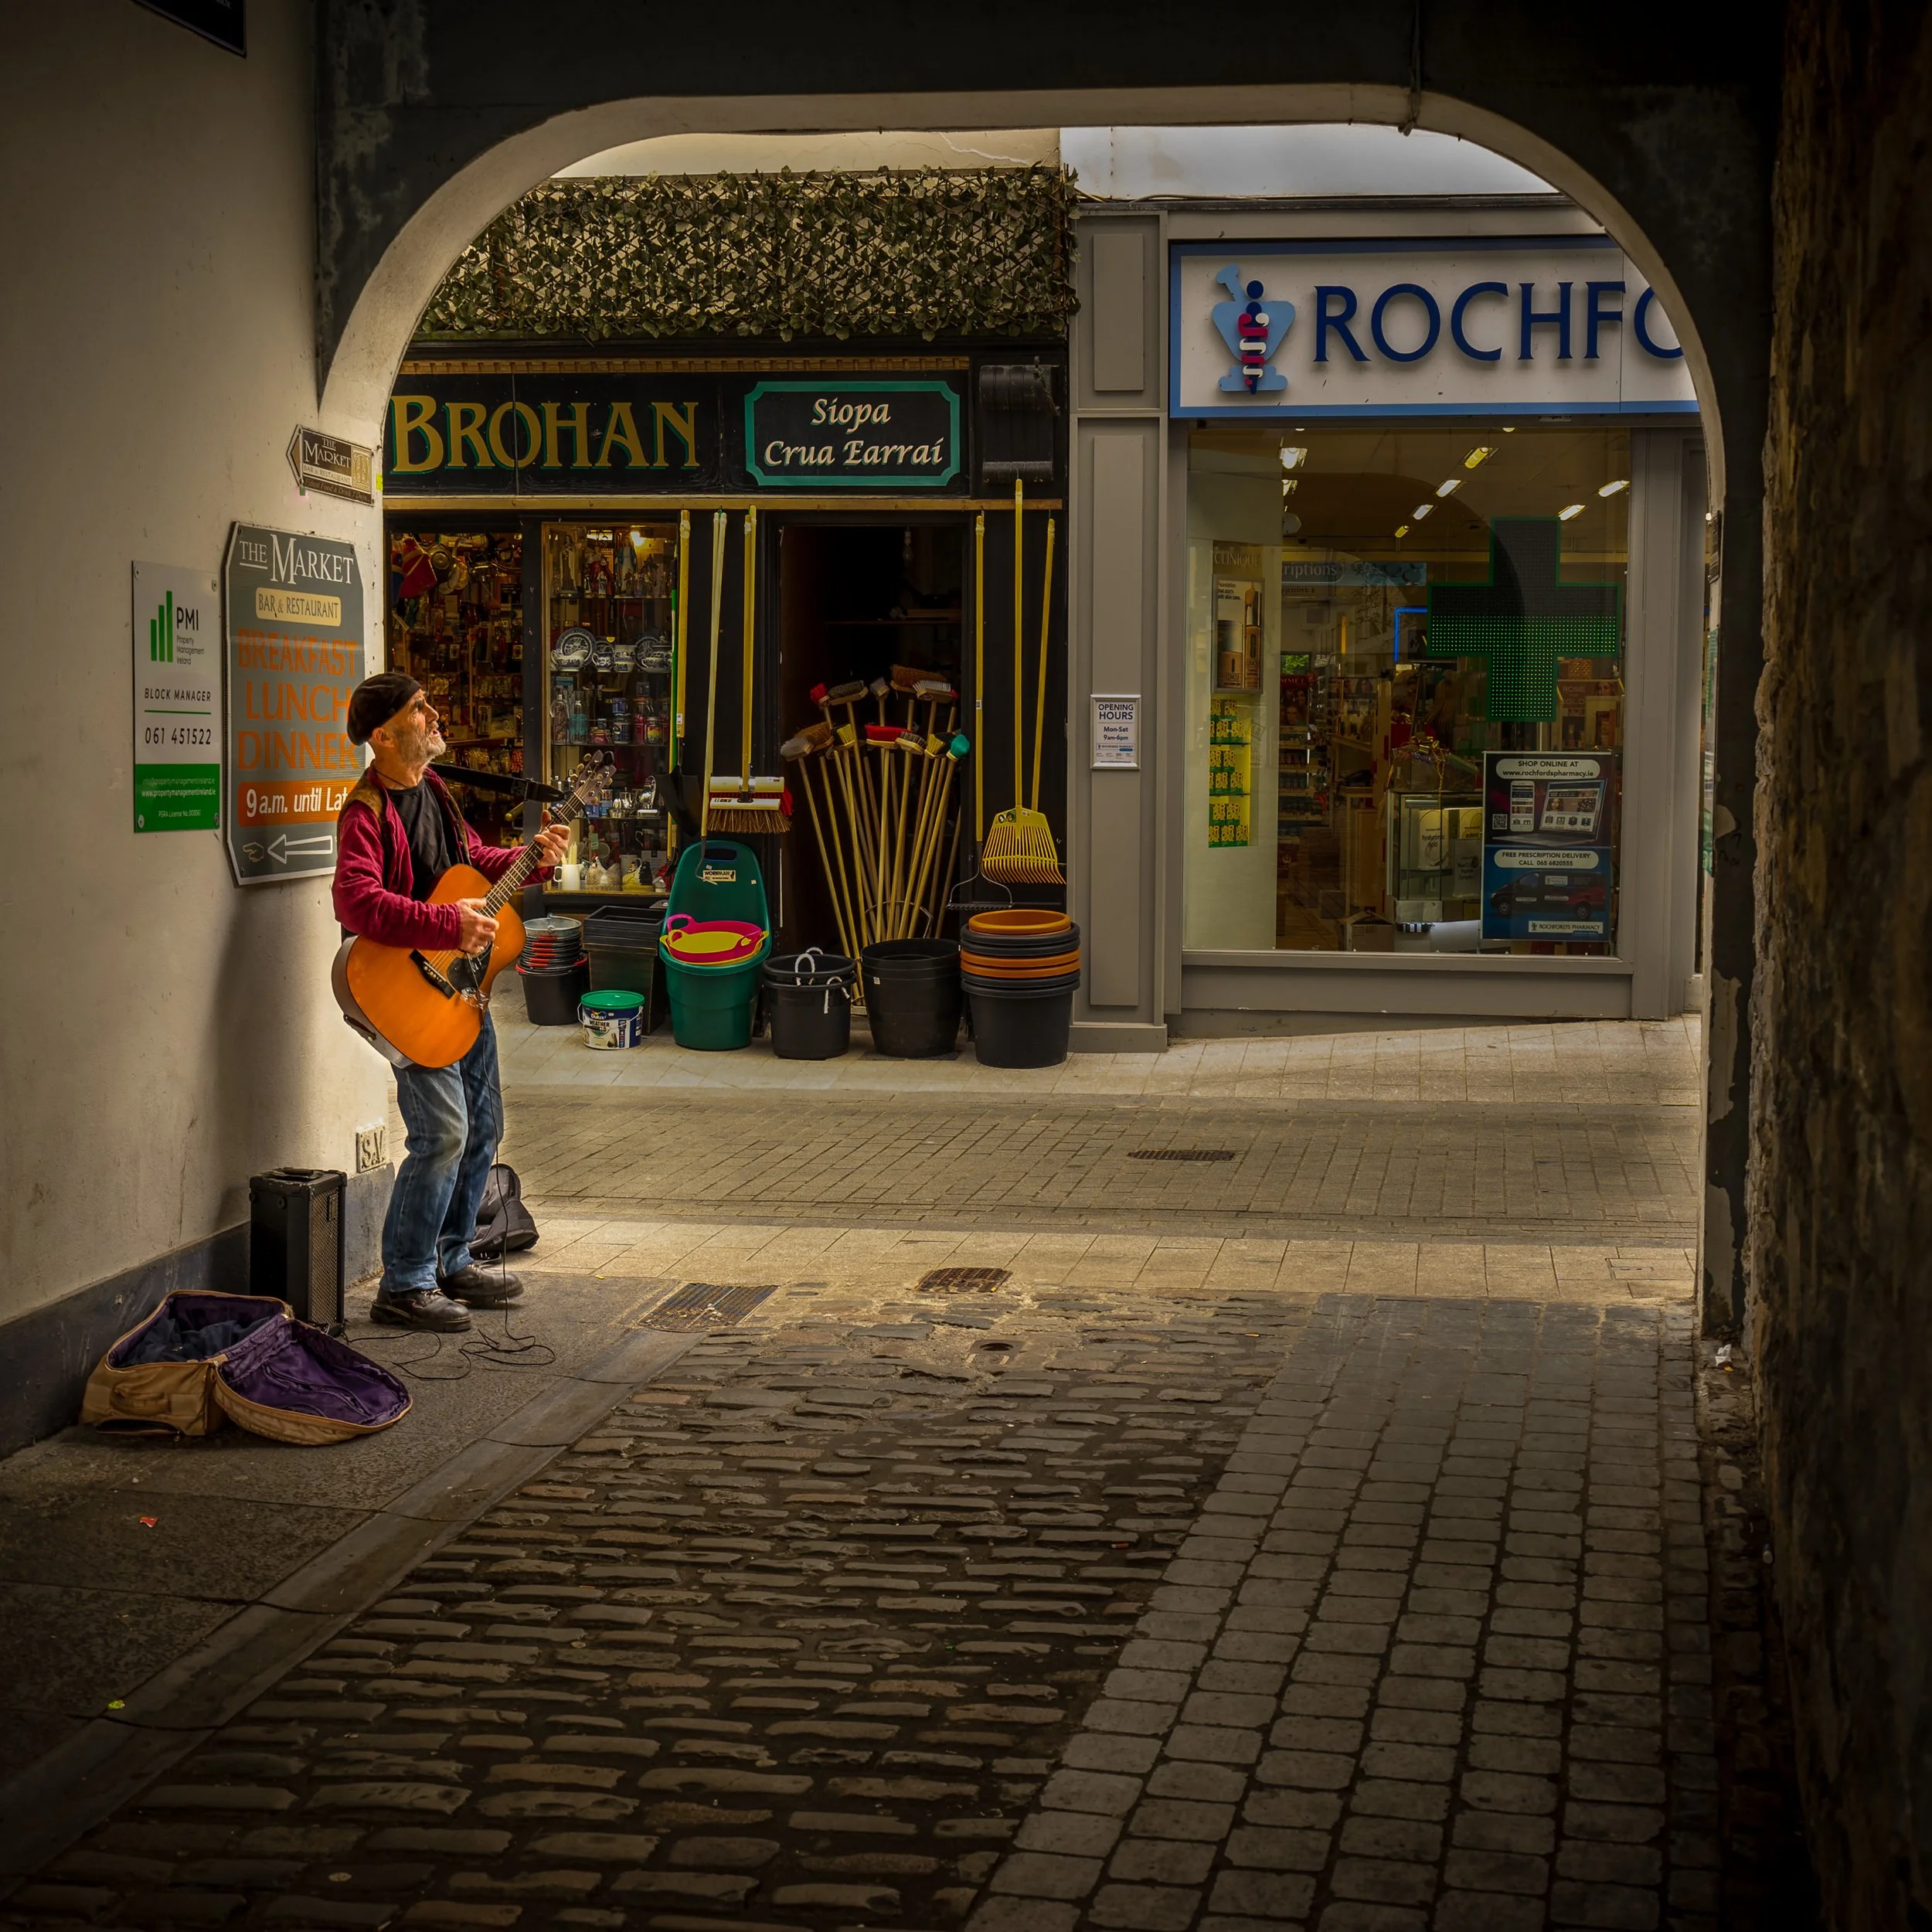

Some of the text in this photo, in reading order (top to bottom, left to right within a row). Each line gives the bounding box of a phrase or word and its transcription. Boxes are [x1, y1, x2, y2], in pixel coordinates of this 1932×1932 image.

[810, 397, 892, 434] Síopa
[321, 438, 336, 450] THE
[389, 395, 699, 473] BROHAN
[304, 439, 351, 468] MARKET
[764, 437, 944, 467] Crua Earraí
[240, 534, 354, 584] THE MARKET
[1214, 552, 1260, 566] CLINIQUE
[258, 593, 338, 619] BAR & RESTAURANT
[177, 607, 199, 631] PMI
[177, 635, 194, 645] Property
[177, 646, 204, 655] Management
[177, 657, 192, 665] Ireland
[238, 628, 358, 678] BREAKFAST
[145, 688, 211, 702] BLOCK MANAGER
[245, 681, 351, 722] LUNCH
[145, 727, 211, 744] 061 451522
[238, 730, 359, 770] DINNER
[1502, 769, 1594, 777] www.rochfordspharmacy.ie
[294, 787, 321, 812] until
